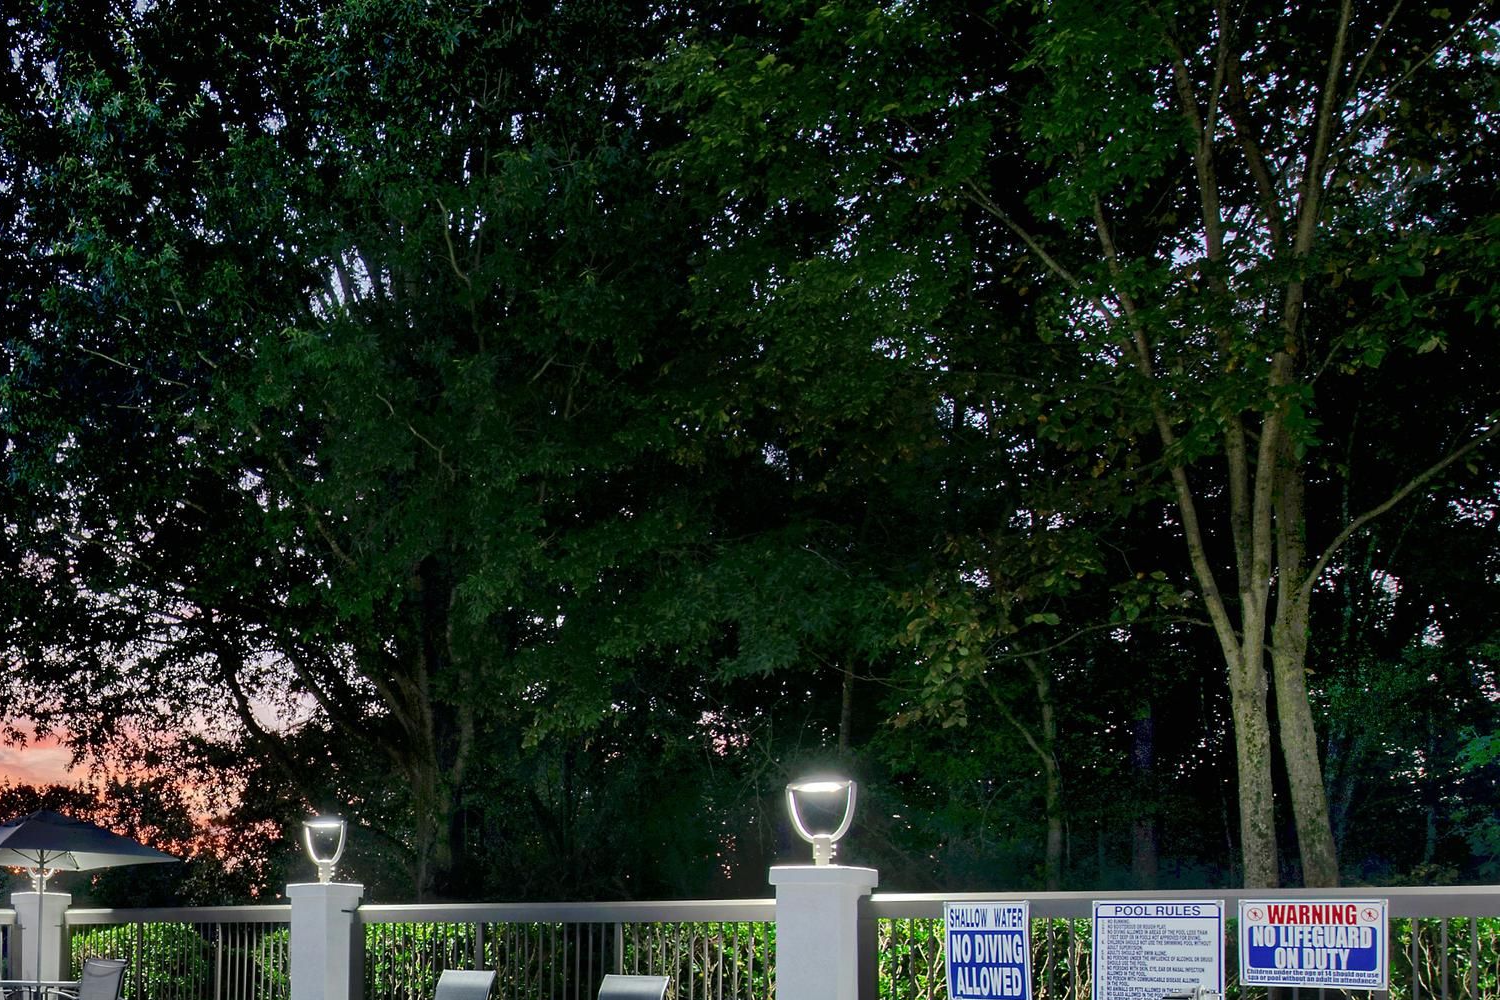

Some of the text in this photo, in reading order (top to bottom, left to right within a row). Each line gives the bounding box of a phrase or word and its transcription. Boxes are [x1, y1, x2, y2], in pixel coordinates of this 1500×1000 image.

[949, 908, 1023, 928] SHALLOW WATER
[1114, 906, 1201, 916] POOL RULES
[1267, 904, 1357, 925] WARNING
[1252, 926, 1372, 948] NO LIFEGUARD
[951, 933, 1024, 964] NO DIVING
[1274, 948, 1350, 970] ON DUTY
[956, 966, 1022, 996] ALLOWED
